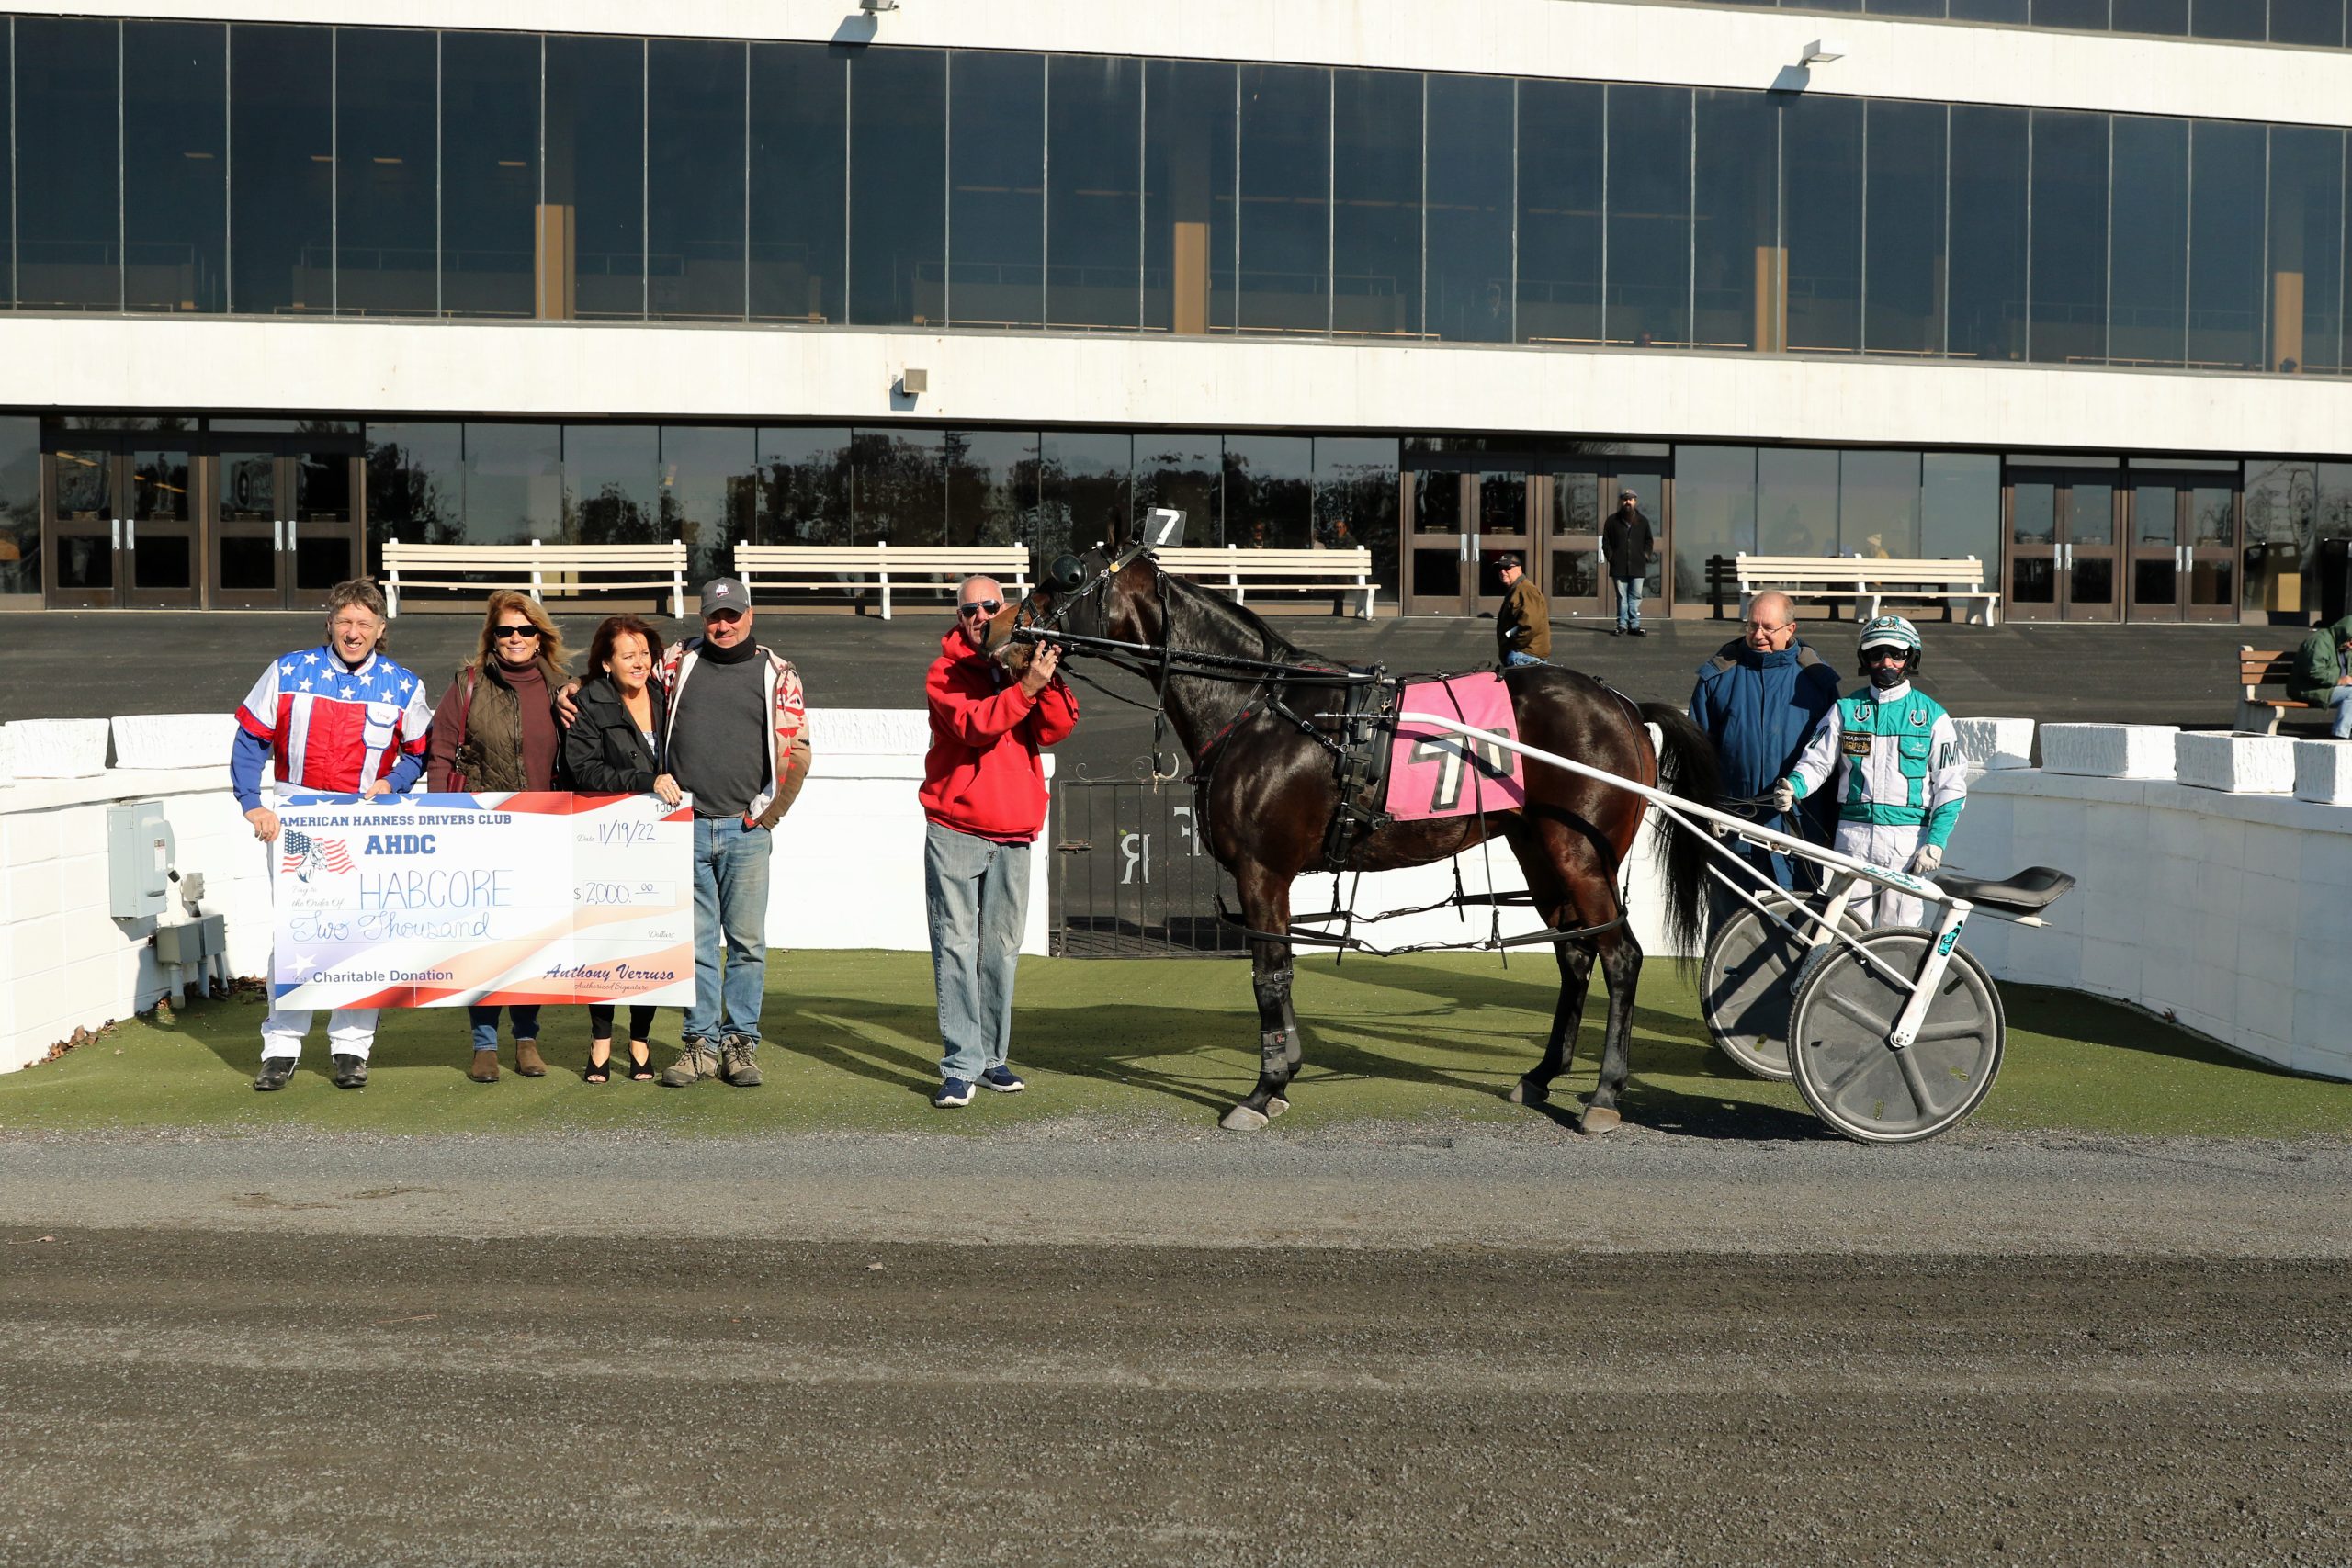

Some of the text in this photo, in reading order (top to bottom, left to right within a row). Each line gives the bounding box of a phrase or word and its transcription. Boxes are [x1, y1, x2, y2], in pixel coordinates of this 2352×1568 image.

[1155, 508, 1181, 545] 7
[1939, 740, 1961, 770] M
[1411, 733, 1468, 811] 7
[279, 814, 512, 827] AMERICAN HARNESS DRIVERS CLUB
[599, 819, 656, 848] 11/19/22
[364, 834, 436, 855] AHDC
[360, 870, 514, 910] HABCORE
[573, 887, 582, 901] $
[290, 909, 502, 942] Two Thousand
[648, 930, 676, 939] Dollars
[312, 969, 454, 984] Charitable Donation
[543, 963, 676, 983] Anthony Verruso
[615, 982, 649, 993] Signature
